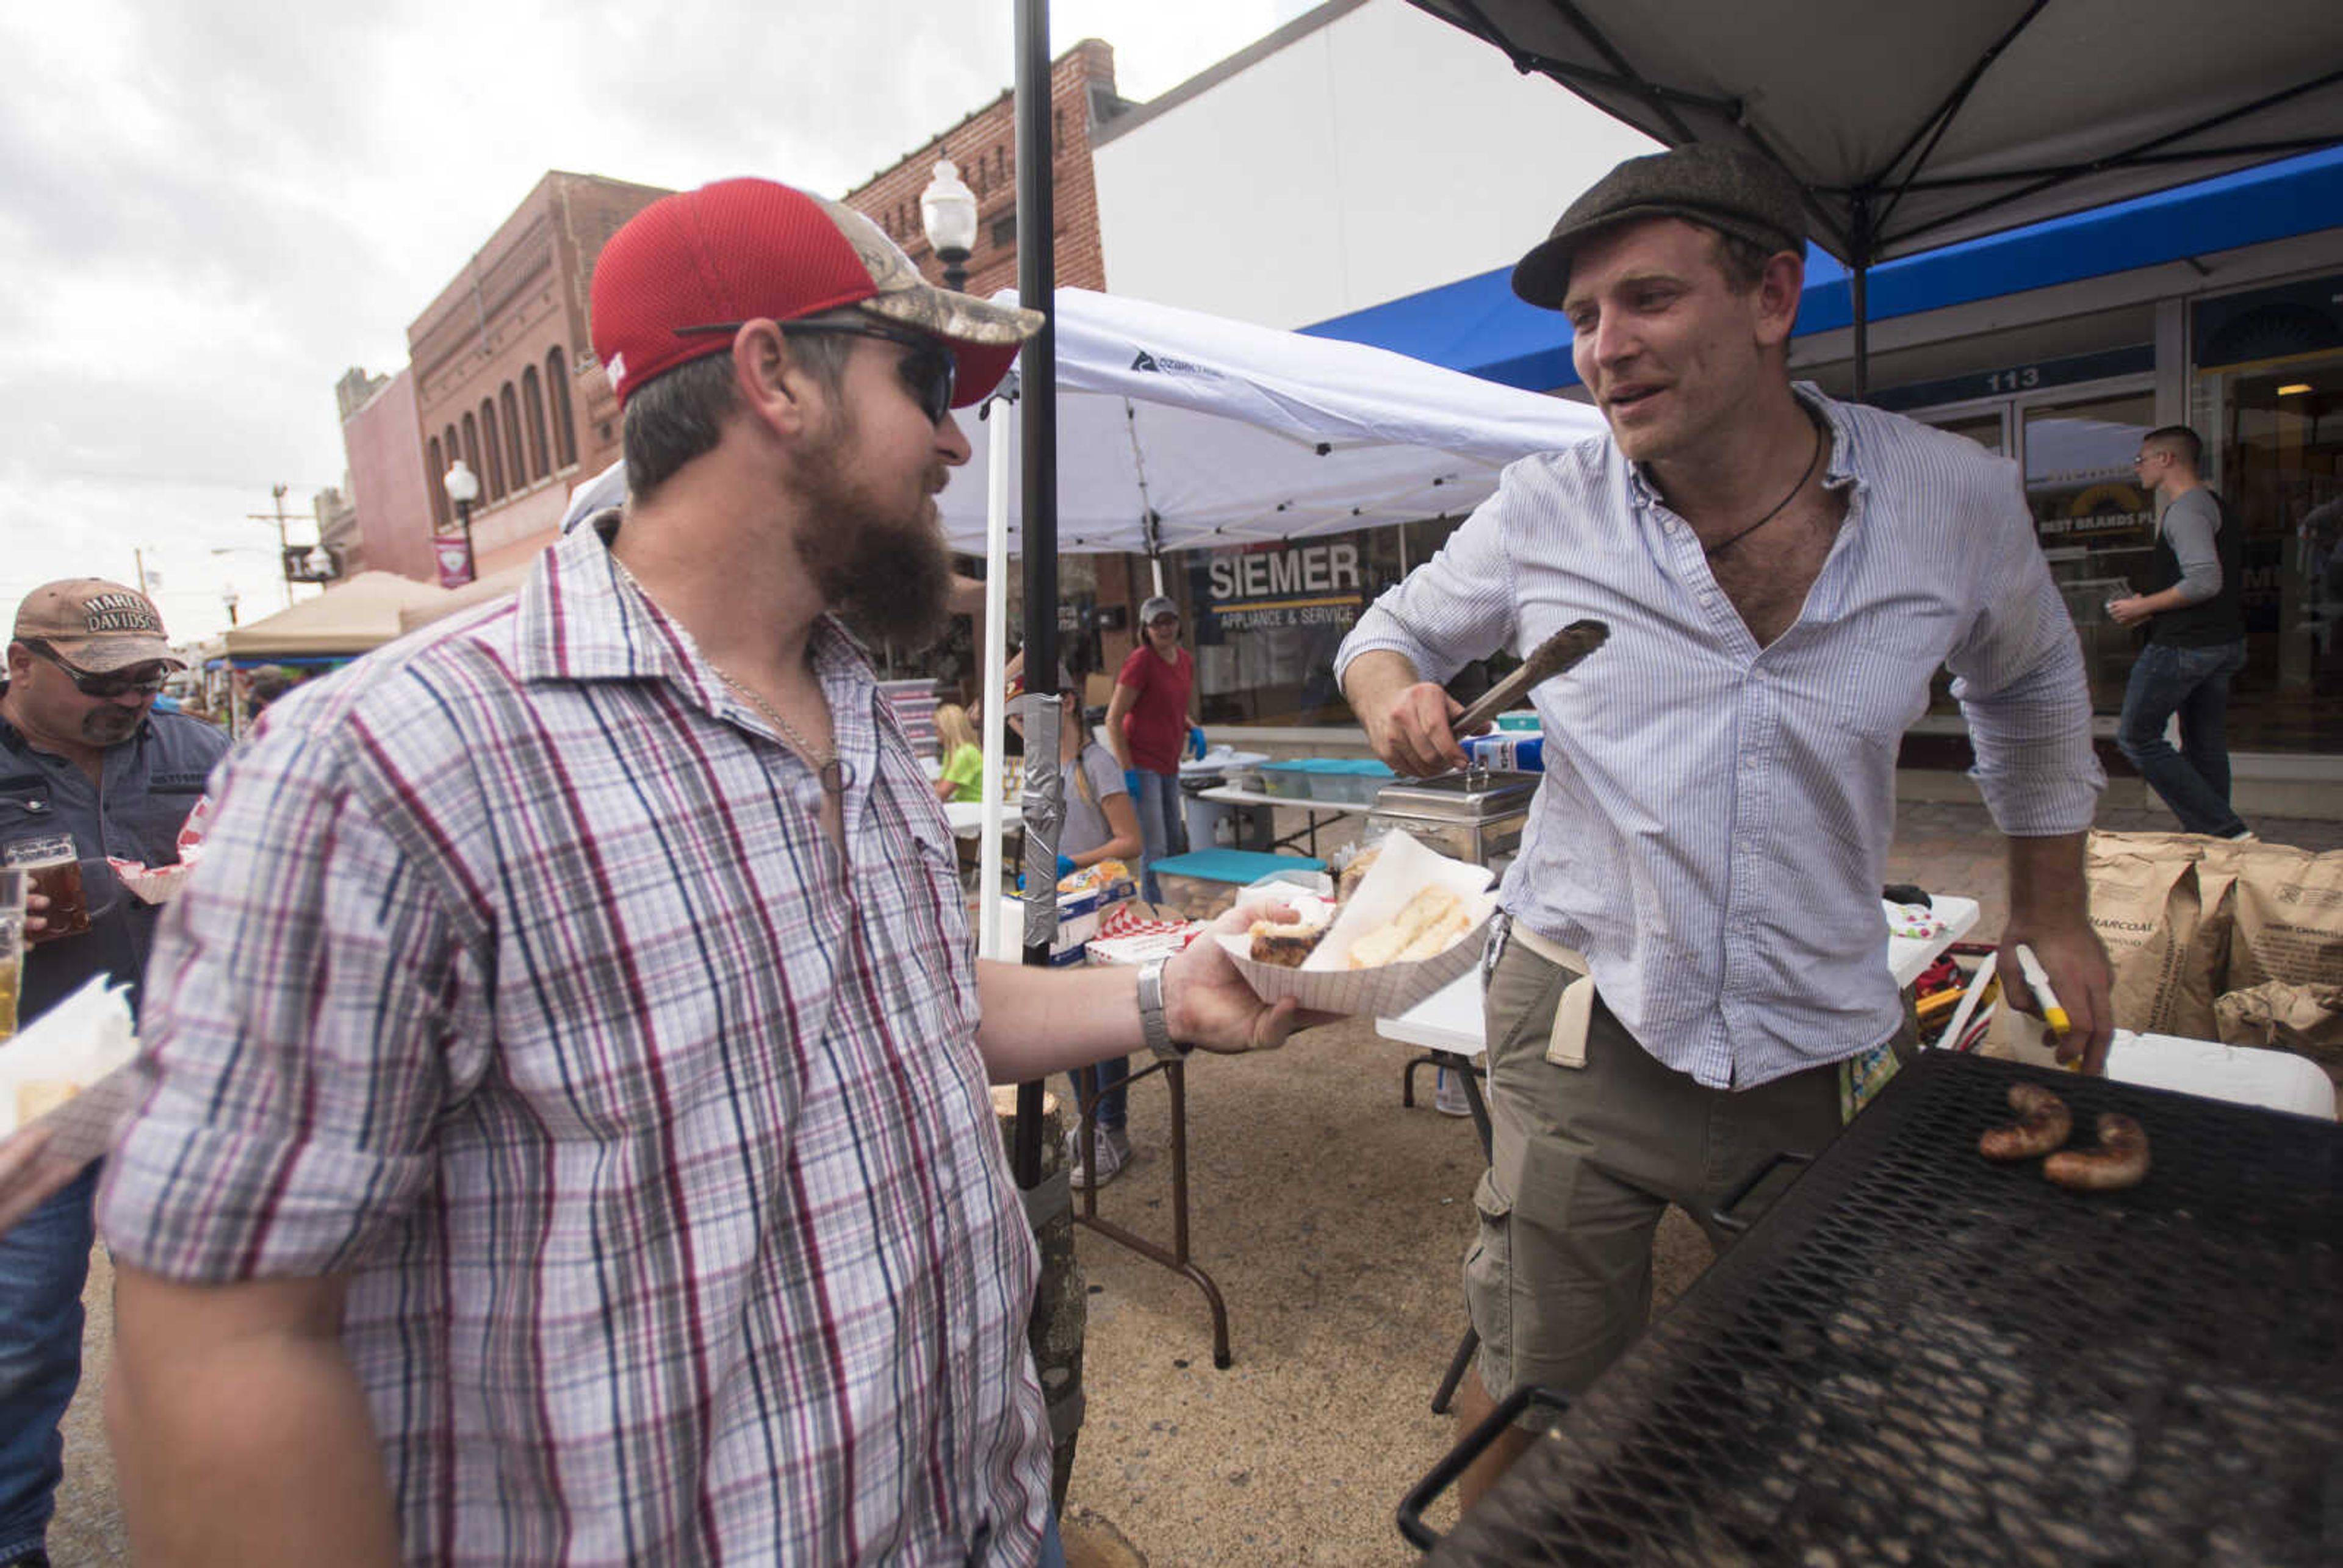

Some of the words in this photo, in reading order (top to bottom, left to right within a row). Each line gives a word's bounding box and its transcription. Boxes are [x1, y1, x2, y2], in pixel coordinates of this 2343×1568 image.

[1986, 367, 2039, 391] 113
[2076, 514, 2134, 530] BRANDS
[1209, 544, 1360, 599] SIEMER
[88, 613, 160, 632] DAVIDSO
[1222, 611, 1281, 628] APPLIANCE
[1288, 610, 1297, 623] &
[1301, 607, 1354, 624] SERVICE
[2089, 917, 2153, 932] HARCOAL
